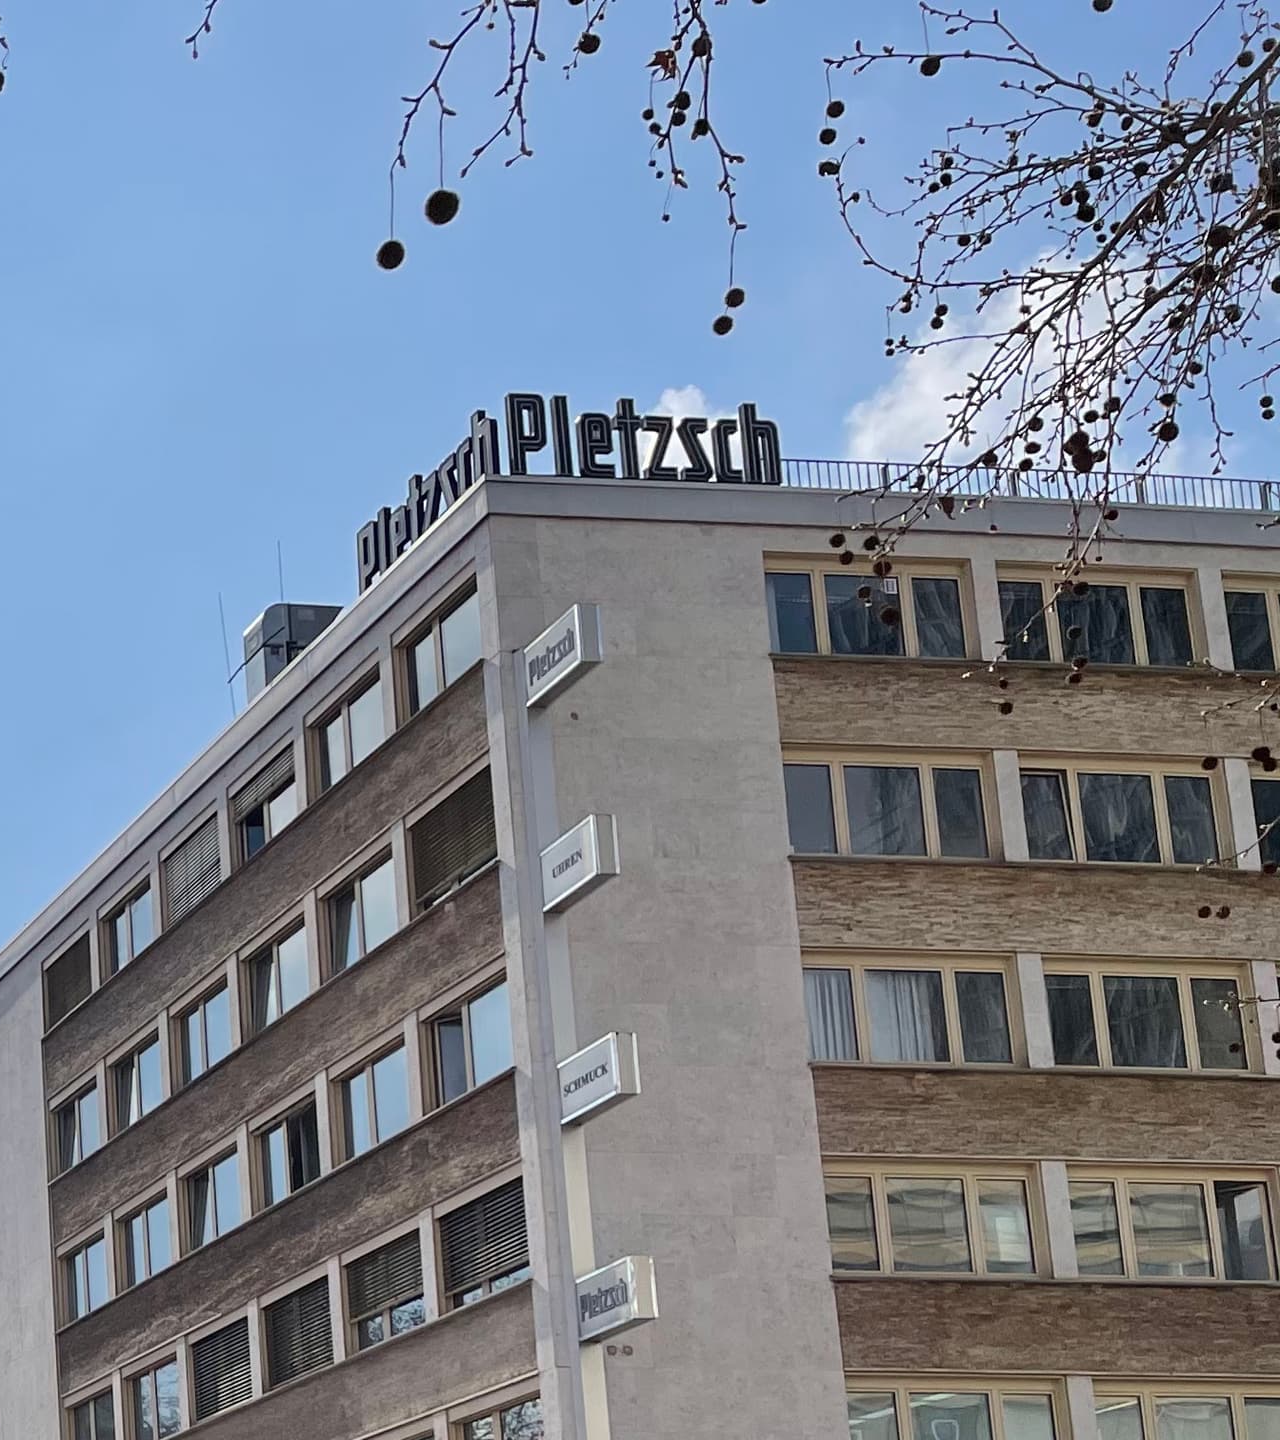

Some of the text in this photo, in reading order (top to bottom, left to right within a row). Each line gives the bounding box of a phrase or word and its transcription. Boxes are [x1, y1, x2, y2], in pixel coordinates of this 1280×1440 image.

[504, 392, 783, 486] Pletzsch
[357, 410, 500, 595] Pletzsch
[528, 628, 575, 687] Pletzsch
[551, 850, 583, 879] UHREN
[563, 1062, 609, 1097] SCHMUCK
[580, 1278, 628, 1322] Pletzsch
